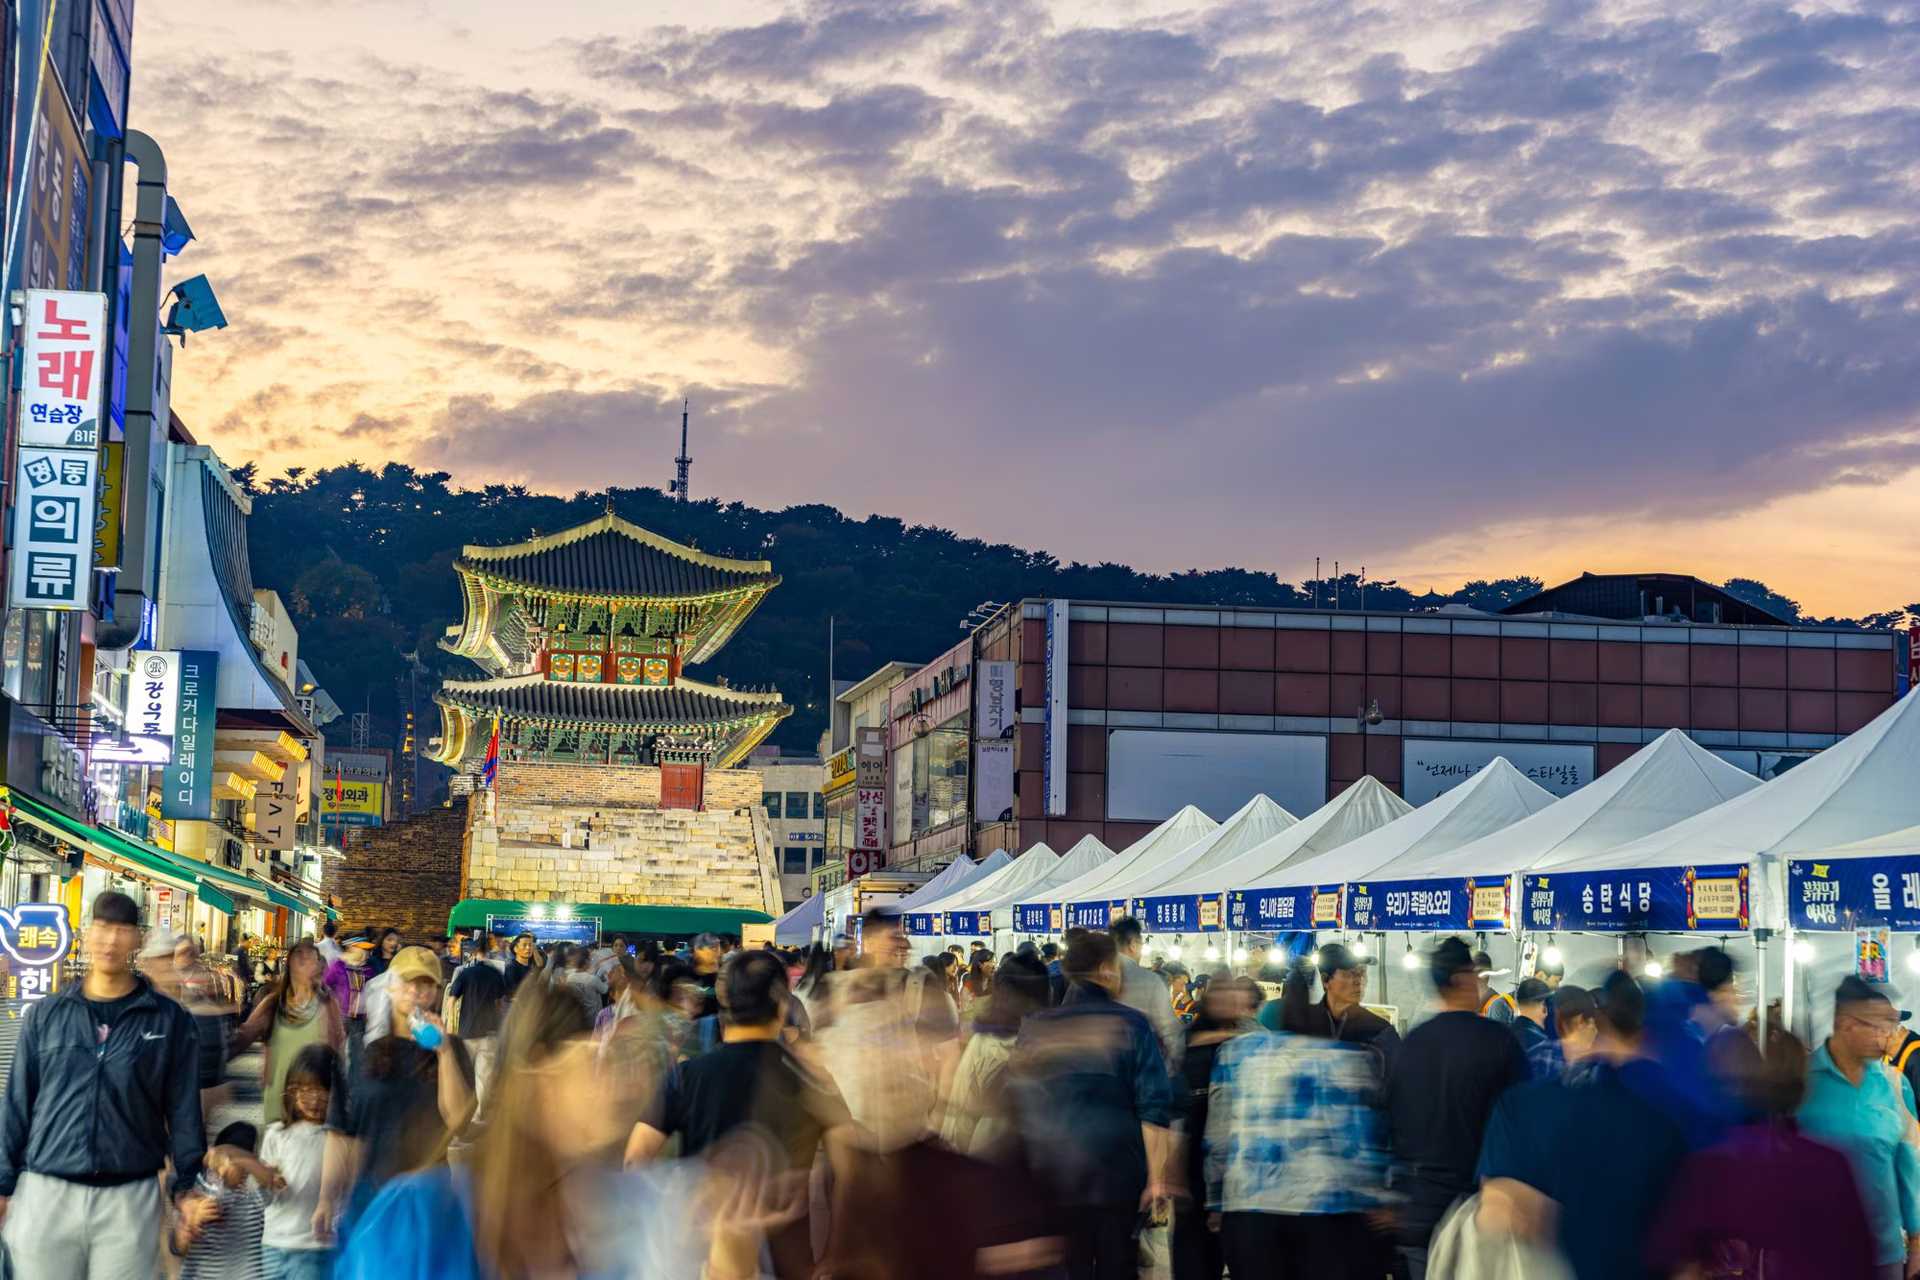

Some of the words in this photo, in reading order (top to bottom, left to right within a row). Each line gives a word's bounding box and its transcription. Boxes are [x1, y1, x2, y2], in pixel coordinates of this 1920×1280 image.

[37, 299, 95, 400] 노래
[30, 403, 83, 424] 연습장
[74, 430, 97, 443] B1F
[28, 457, 88, 487] 명동
[31, 500, 76, 597] 의류
[178, 664, 200, 806] 크로커다일레이디
[861, 760, 883, 773] 헤어
[1527, 765, 1579, 786] 스타일을
[1259, 897, 1276, 919] 우니아
[1386, 892, 1409, 917] 우리가
[1410, 890, 1451, 916] 족발&오리
[1582, 882, 1651, 914] 송탄식당
[1806, 902, 1836, 924] 야시장
[18, 926, 59, 949] 쾌속
